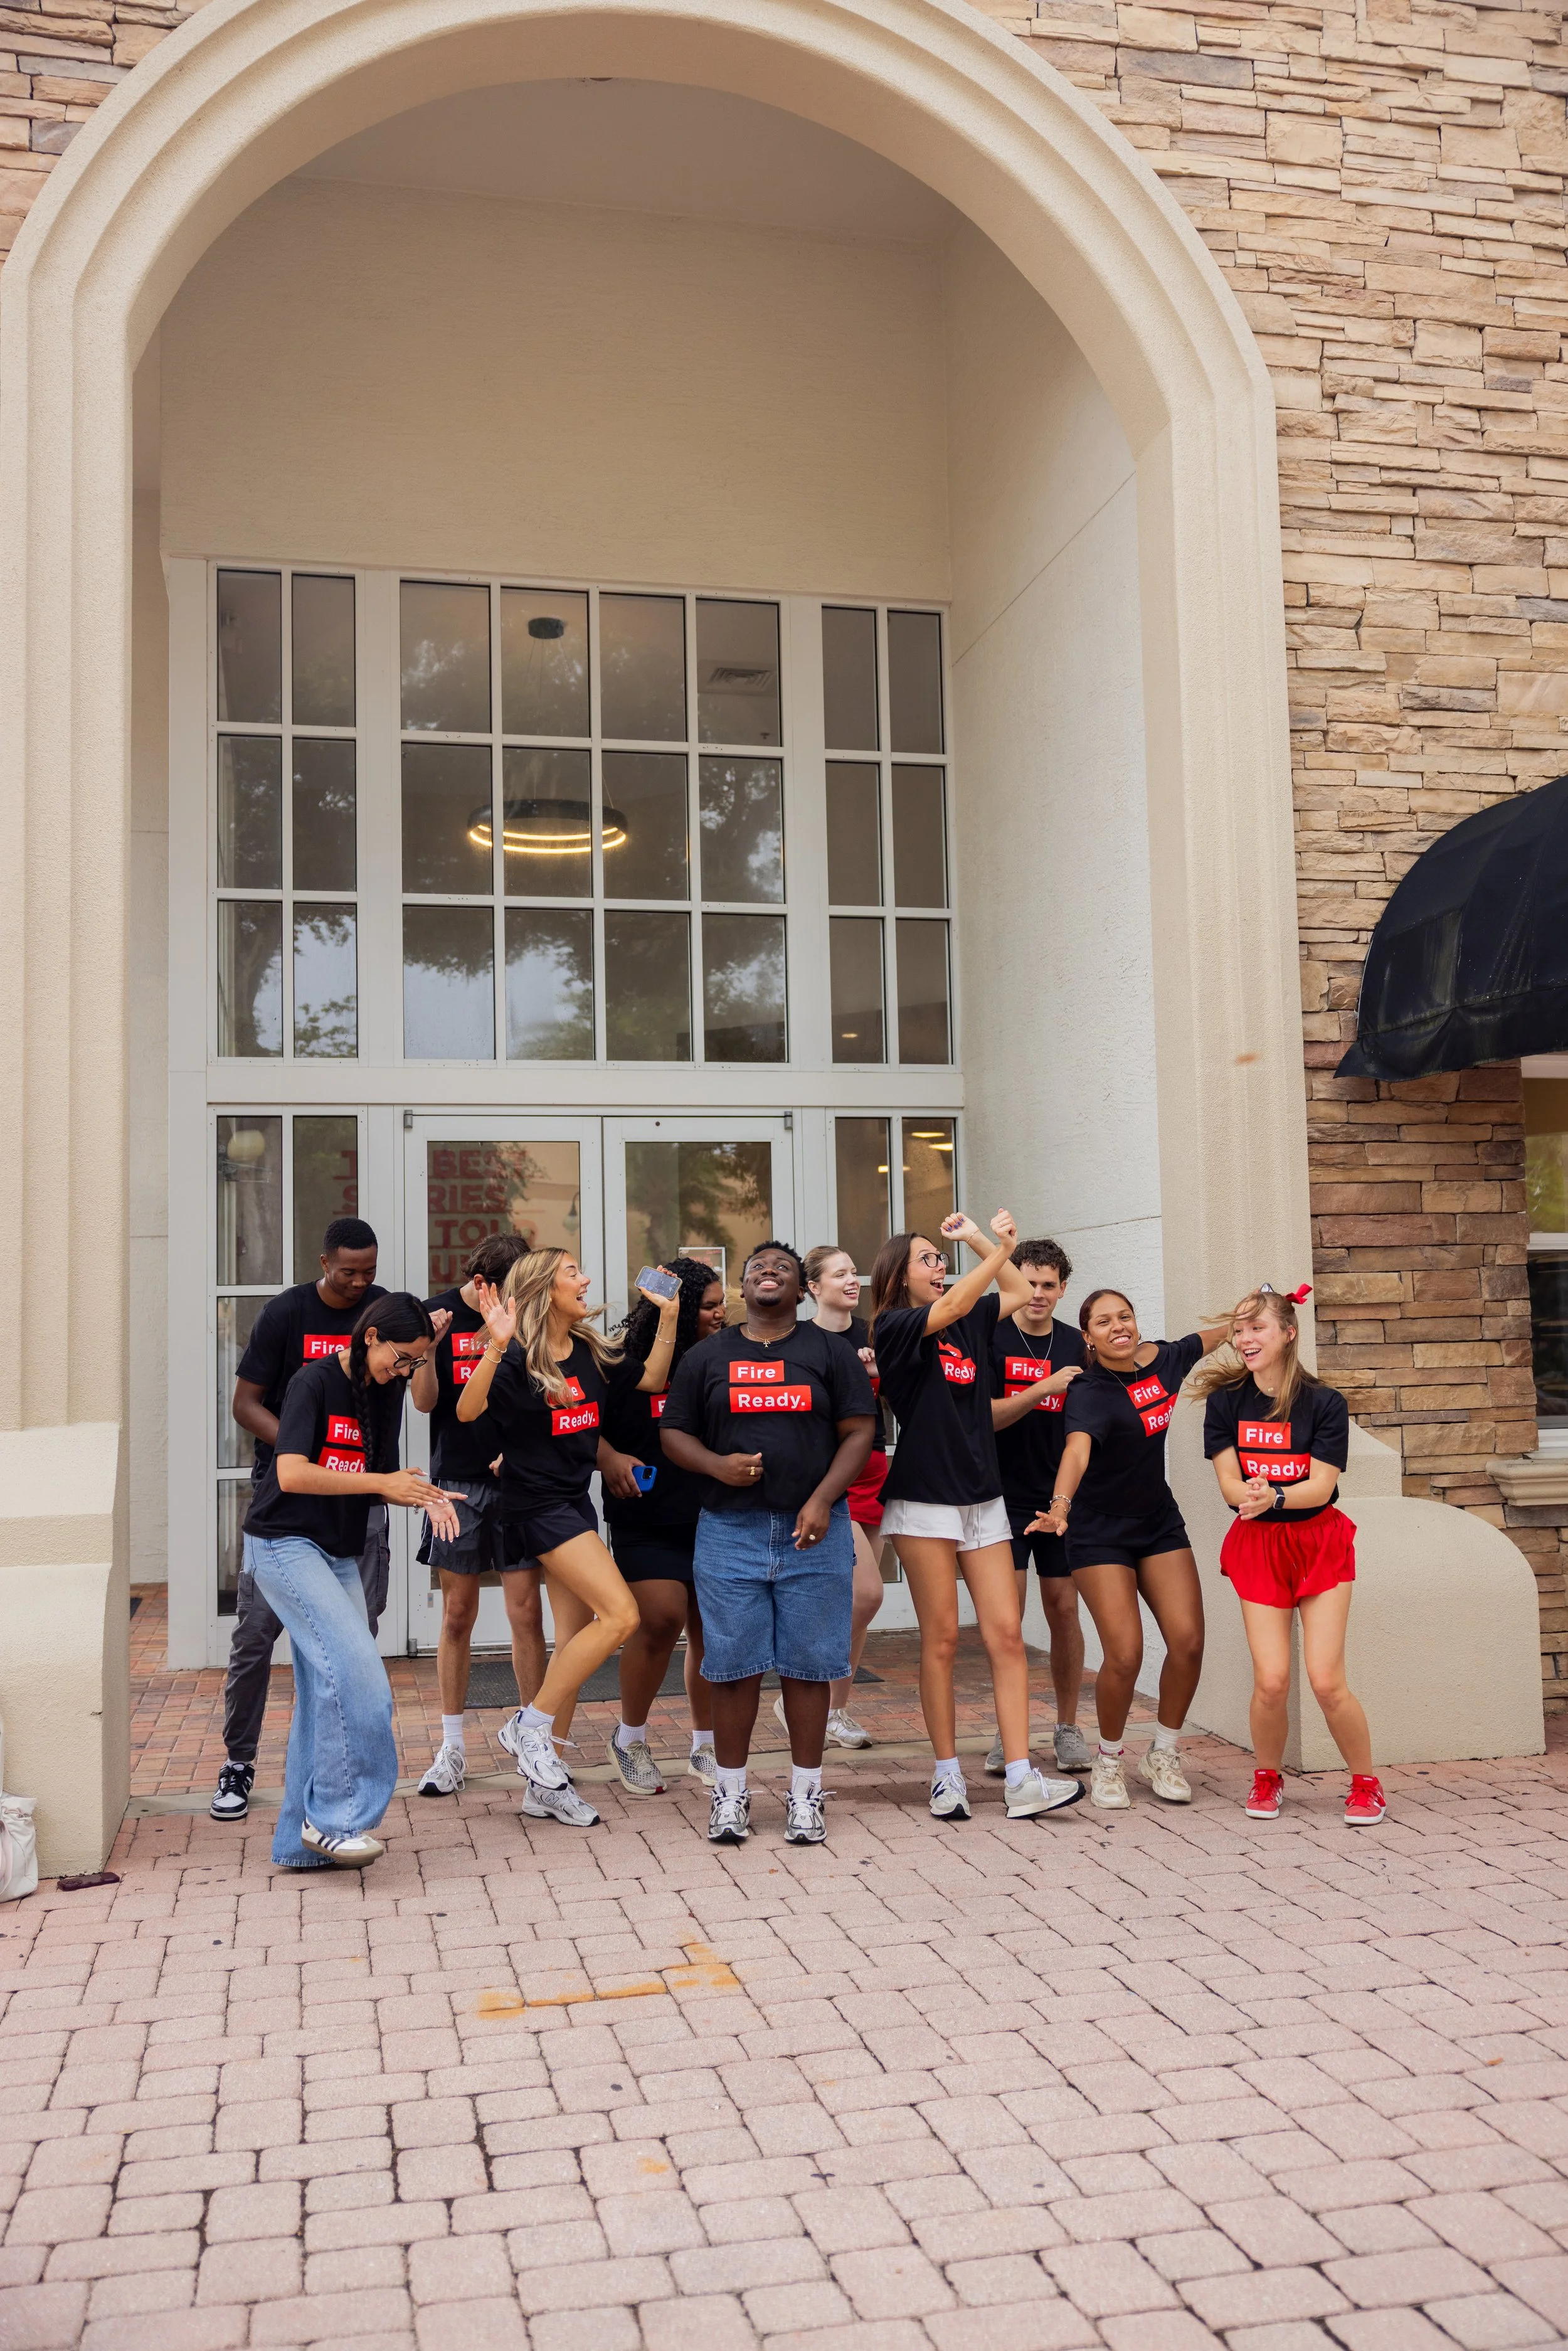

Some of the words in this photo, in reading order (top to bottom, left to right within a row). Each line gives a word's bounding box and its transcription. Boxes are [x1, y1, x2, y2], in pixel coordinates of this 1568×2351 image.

[311, 1341, 344, 1354] Fire
[738, 1366, 776, 1379] Fire
[1012, 1362, 1044, 1377] Fire
[738, 1392, 805, 1409] Ready.
[1133, 1385, 1160, 1403] Fire
[559, 1410, 595, 1430] Ready.
[1147, 1405, 1174, 1430] Read
[334, 1423, 359, 1441] Fire
[1246, 1428, 1283, 1444] Fire
[1246, 1460, 1308, 1478] Ready.
